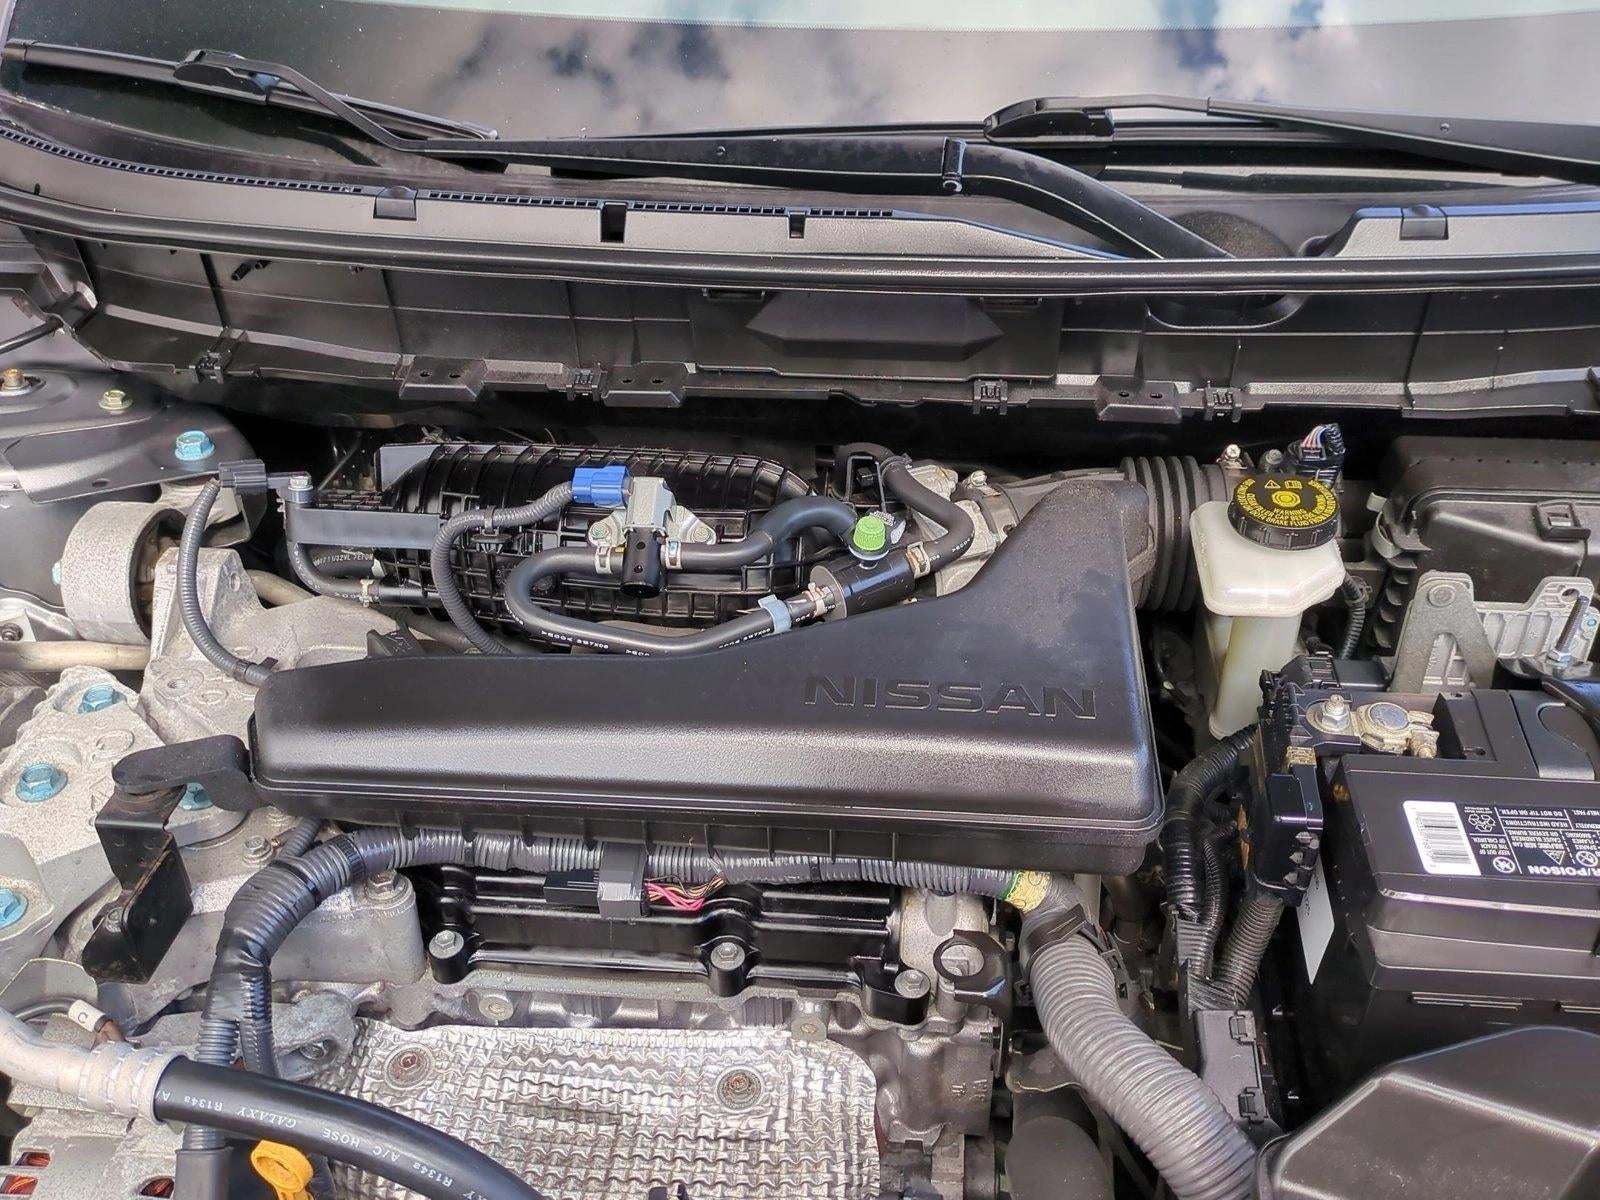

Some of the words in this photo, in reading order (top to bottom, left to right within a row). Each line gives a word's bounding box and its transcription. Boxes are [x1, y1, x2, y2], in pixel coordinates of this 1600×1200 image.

[1273, 508, 1308, 516] WARNING
[803, 674, 1097, 720] NISSAN
[184, 1095, 223, 1112] R134a
[235, 1105, 297, 1128] GALAXY
[321, 1127, 360, 1148] HOSE
[371, 1144, 400, 1162] A/C
[412, 1162, 453, 1188] R134a
